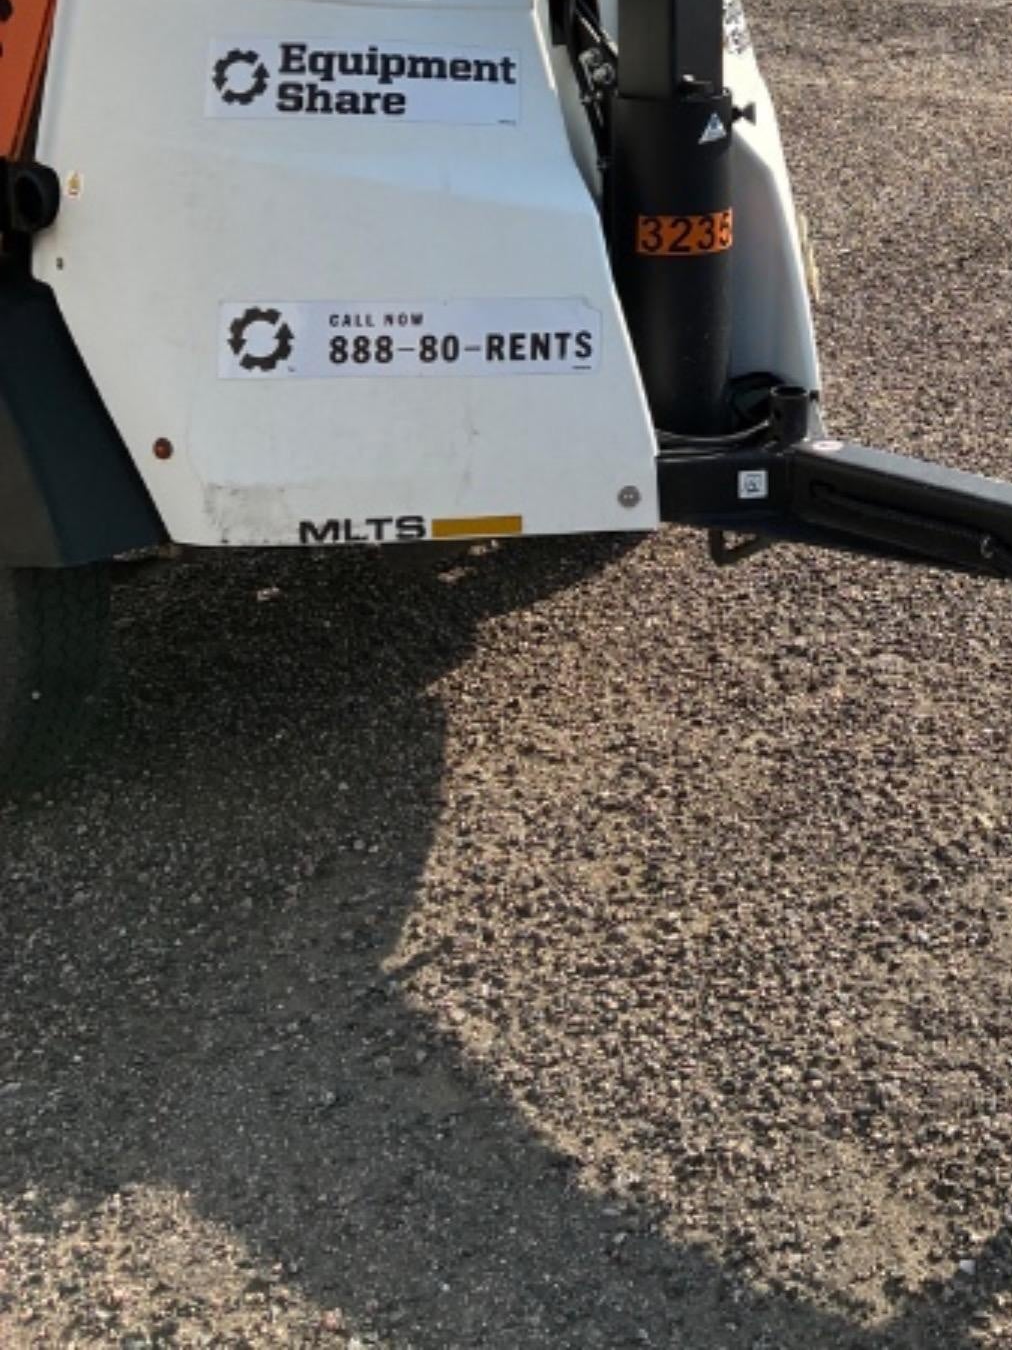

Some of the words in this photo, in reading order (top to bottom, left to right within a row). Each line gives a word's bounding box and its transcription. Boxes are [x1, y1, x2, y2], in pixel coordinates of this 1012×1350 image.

[278, 43, 516, 85] Equipment
[276, 81, 407, 116] Share
[329, 313, 375, 328] CALL
[383, 312, 425, 327] NOW
[329, 330, 593, 365] 888-80-RENTS
[299, 514, 427, 543] MLTS
